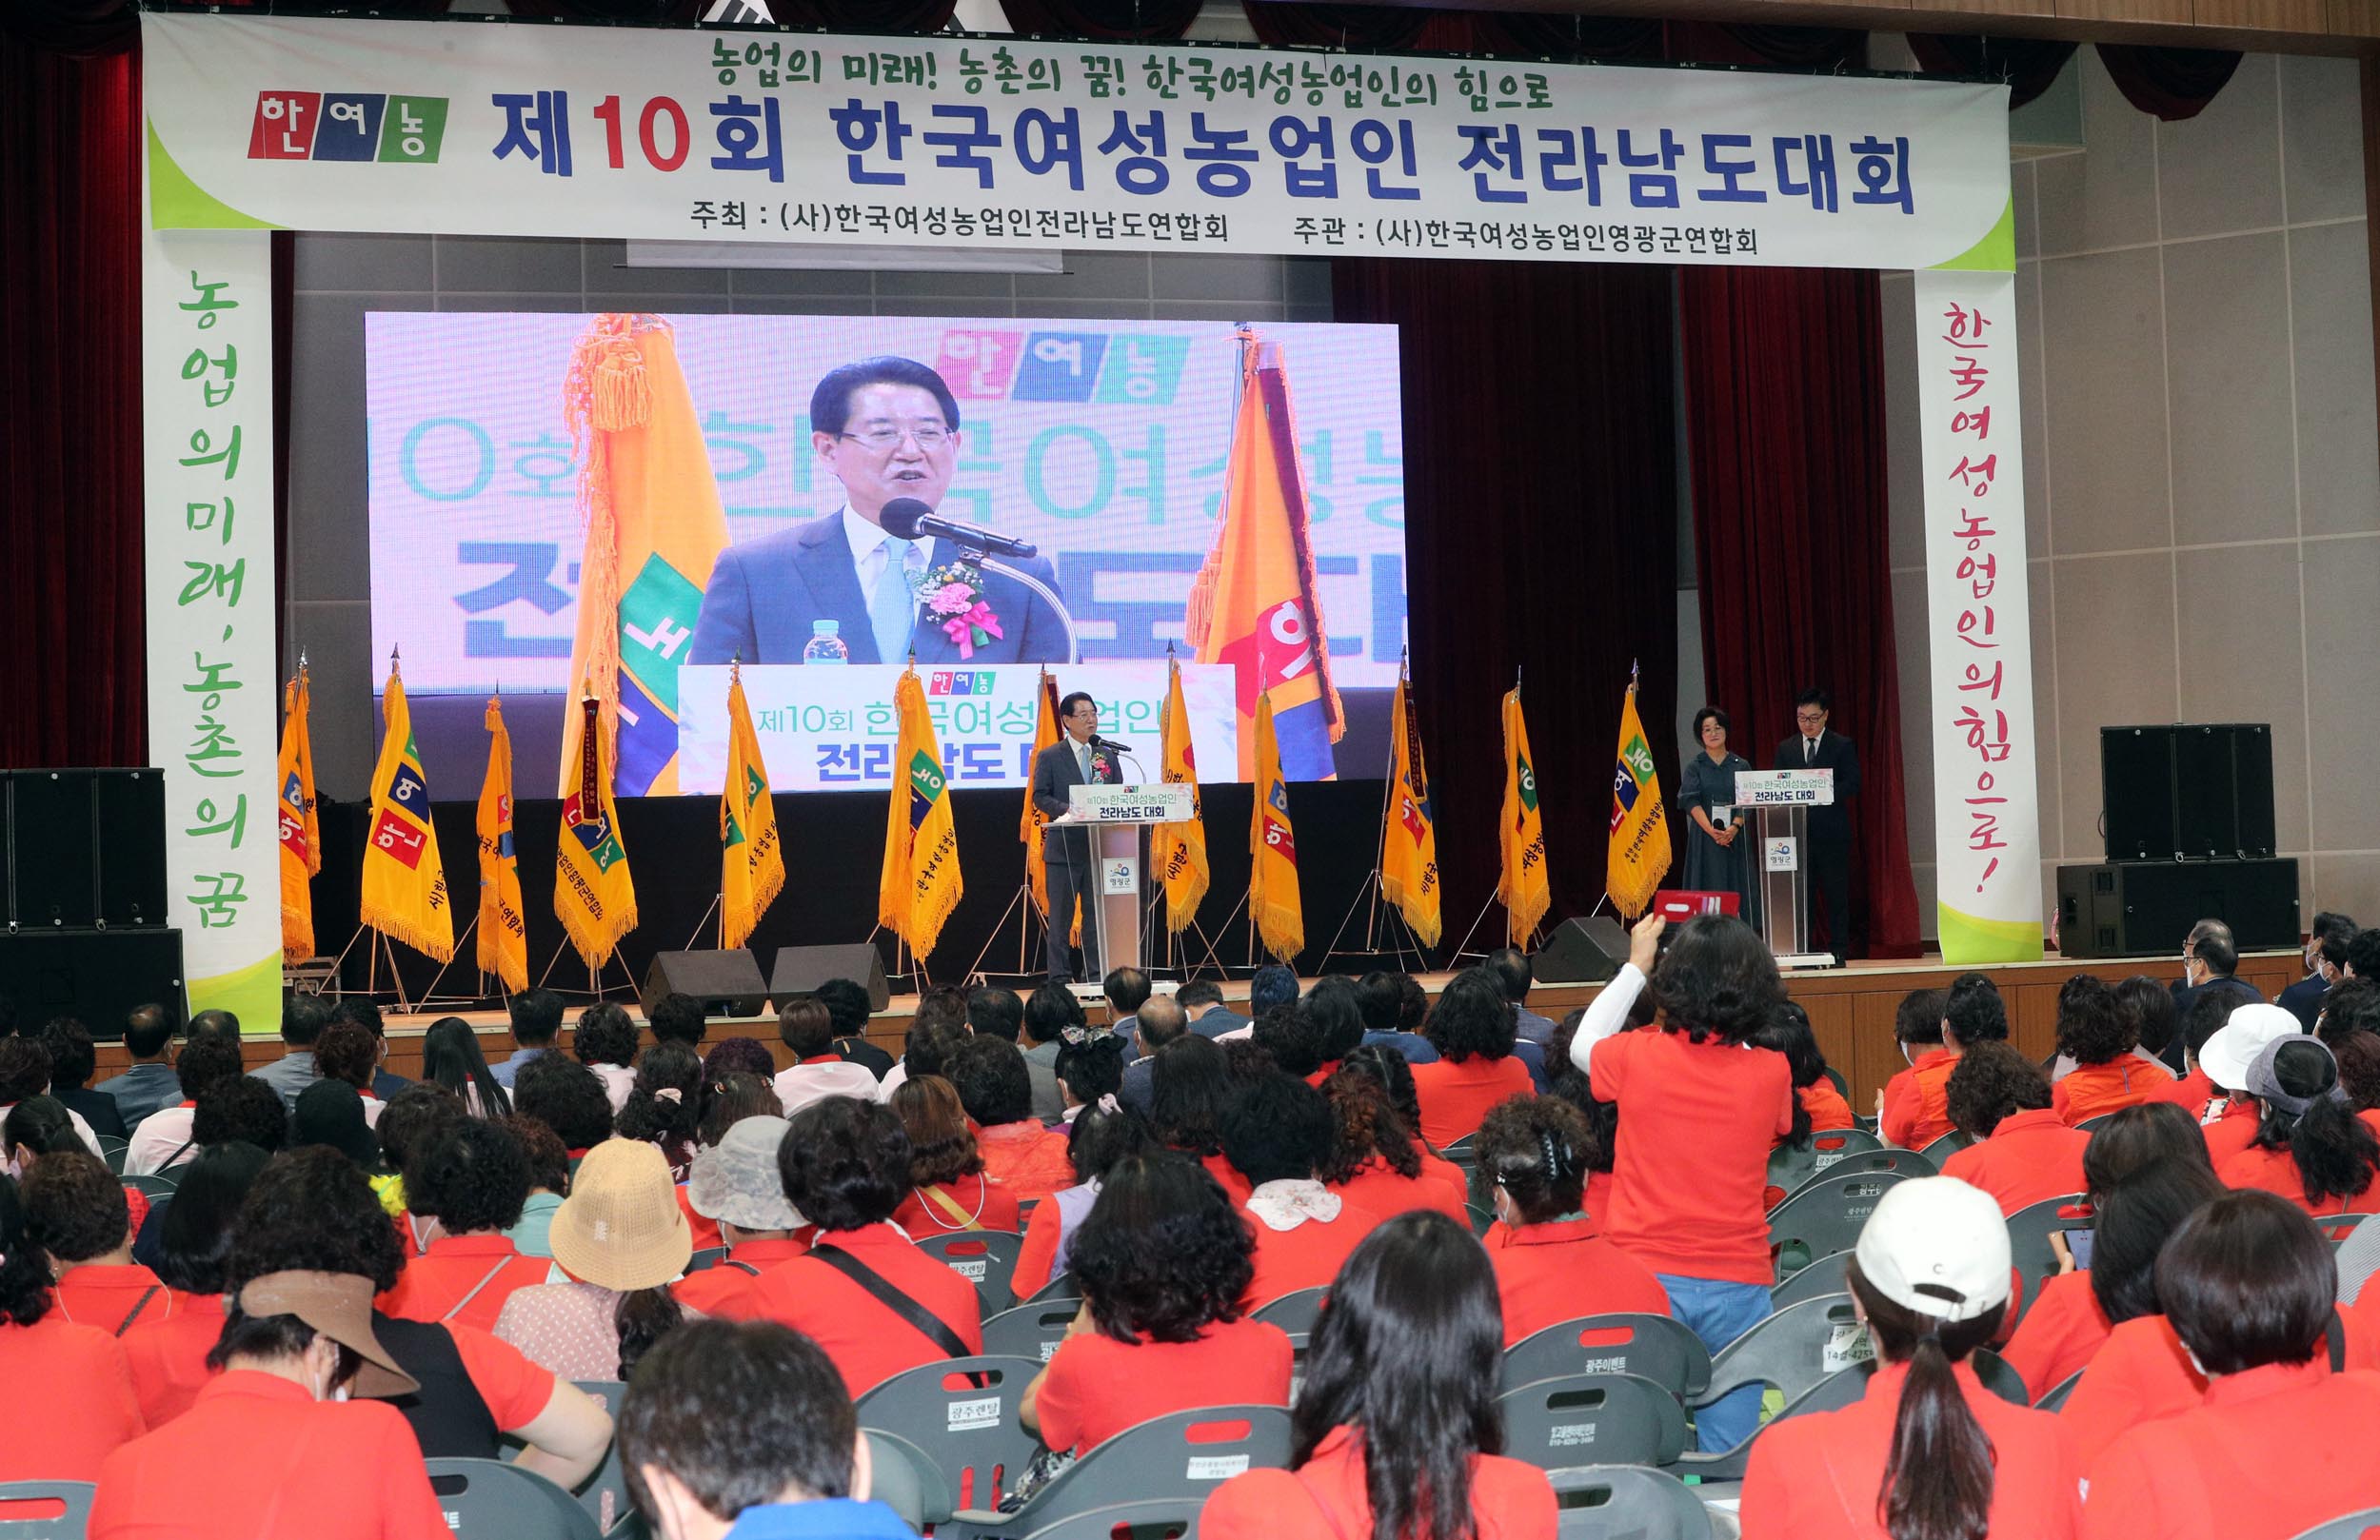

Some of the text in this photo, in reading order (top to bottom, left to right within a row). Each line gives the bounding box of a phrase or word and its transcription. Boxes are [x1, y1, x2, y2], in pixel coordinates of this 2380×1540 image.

[712, 37, 1553, 112] 농업의 미래! 농촌의 꿈! 한국여성농업인의 힘으로
[492, 89, 1914, 215] 제10회 한국여성농업인 전라남도대회
[690, 200, 746, 230] 주최
[780, 201, 1228, 242] (사)한국여성농업인전라남도연합회
[1294, 216, 1345, 245] 주관
[1377, 218, 1756, 255] (사)한국여성농업인영광군연합회
[758, 704, 854, 734] 제10회
[1755, 790, 1815, 801] 전라남도 대회
[1764, 779, 1826, 789] 한국여성농업인
[1110, 794, 1177, 805] 한국여성농업인
[1100, 805, 1165, 819] 전라남도 대회
[1585, 1356, 1626, 1373] 광주이벤트
